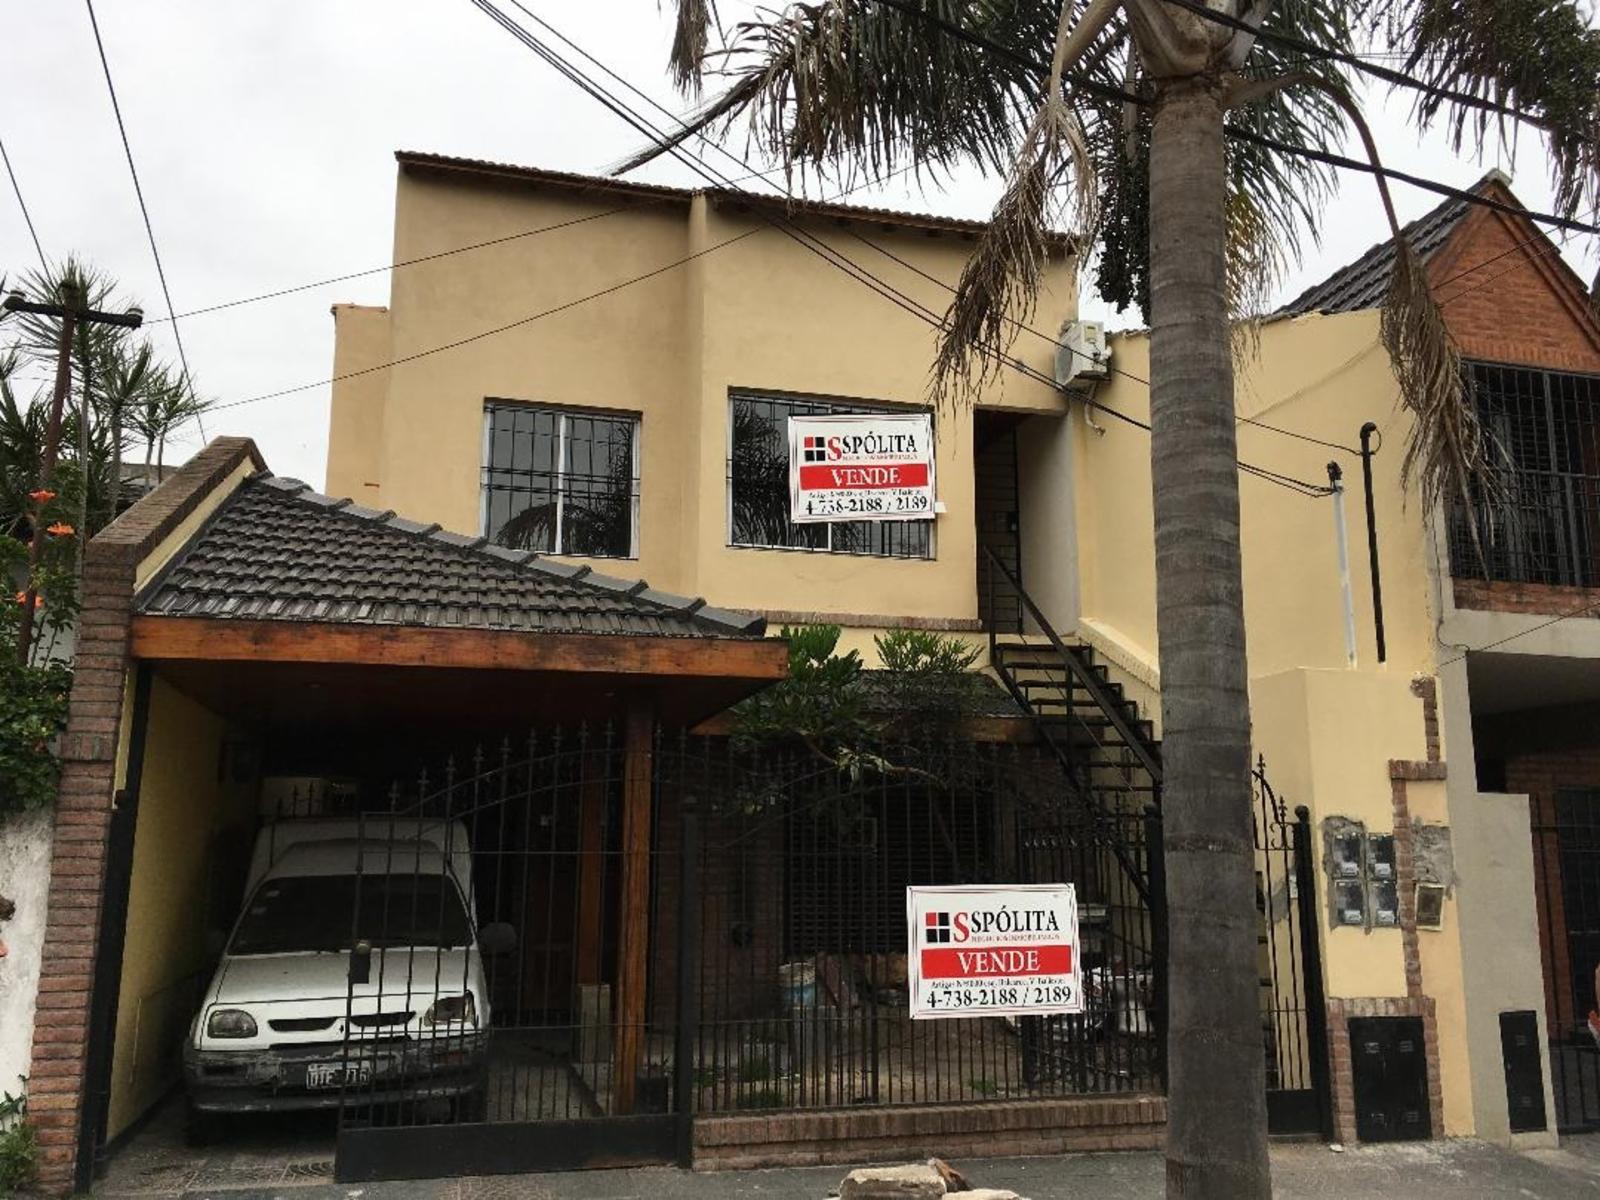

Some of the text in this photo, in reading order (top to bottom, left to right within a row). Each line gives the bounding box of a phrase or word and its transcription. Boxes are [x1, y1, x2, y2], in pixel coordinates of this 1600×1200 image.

[831, 467, 902, 487] VENDE
[956, 950, 1041, 974] VENDE
[926, 988, 1018, 1008] 4-738-2188
[1034, 985, 1072, 1004] 2189
